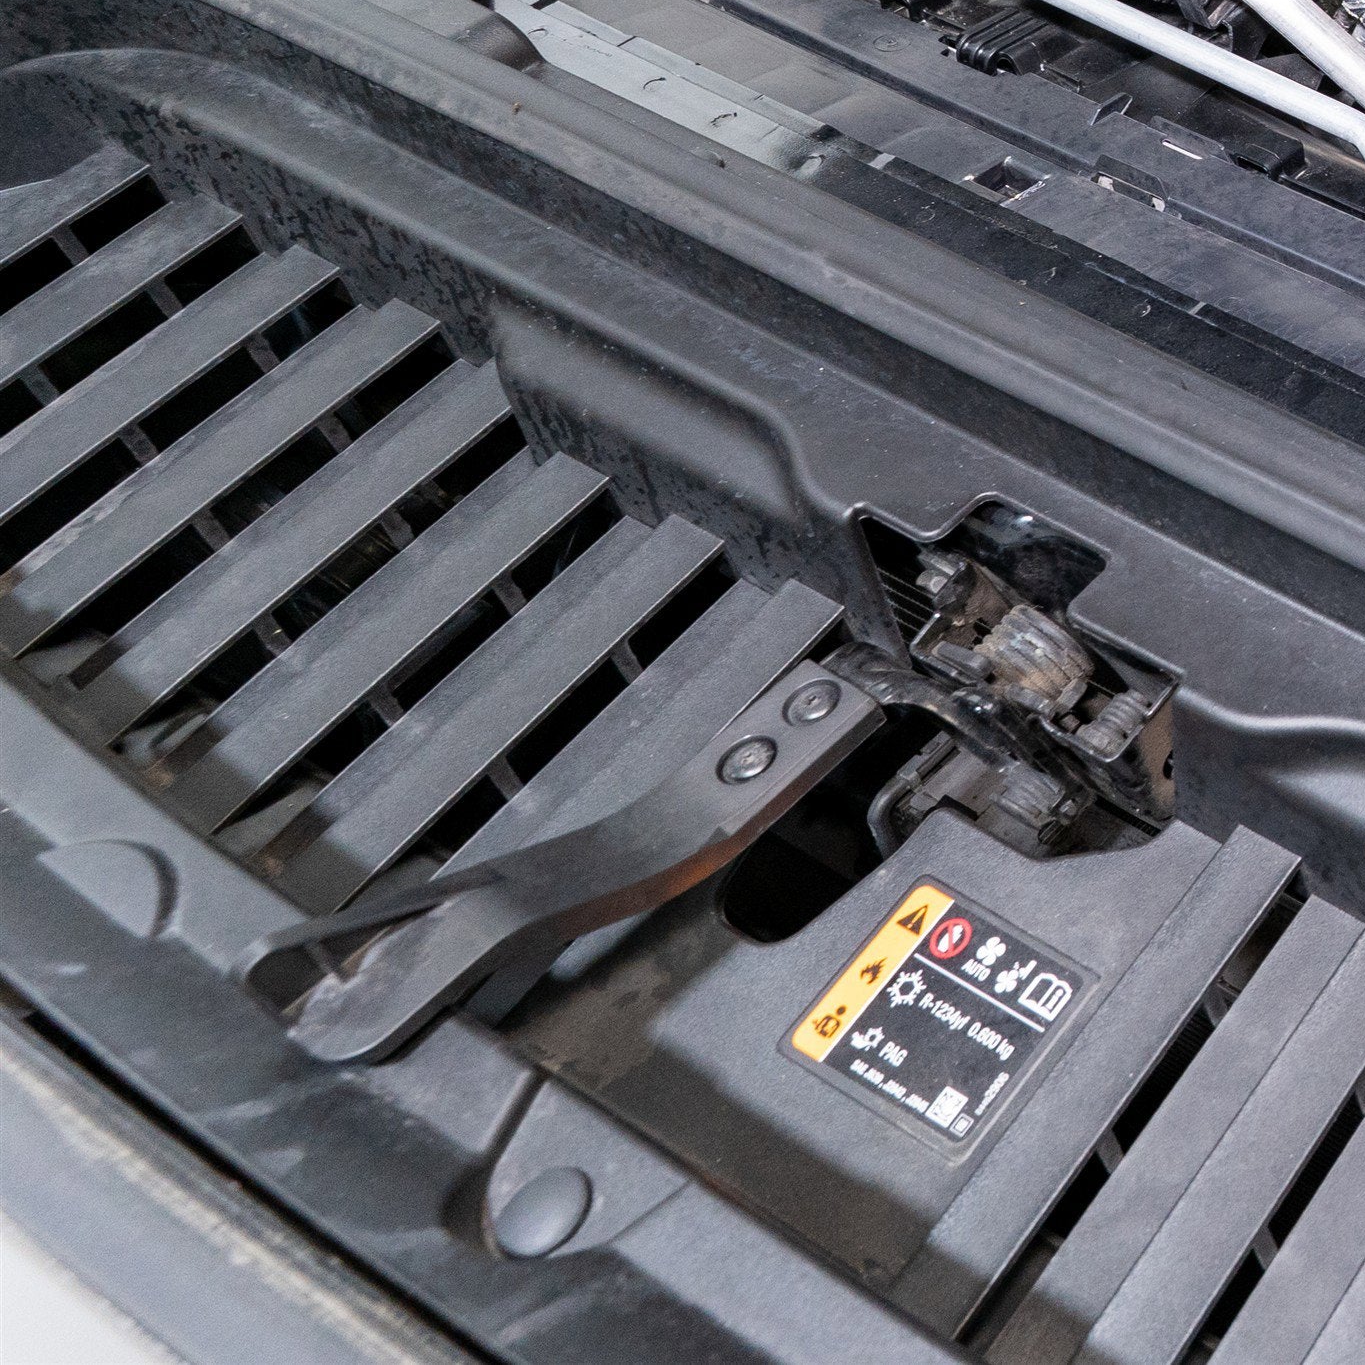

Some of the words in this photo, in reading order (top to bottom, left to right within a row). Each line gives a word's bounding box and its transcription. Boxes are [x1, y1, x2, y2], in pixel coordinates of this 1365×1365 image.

[960, 959, 991, 982] AUTO
[918, 992, 971, 1031] R-1234yf
[967, 1021, 1003, 1051] 0.600
[995, 1038, 1016, 1062] kg
[878, 1040, 908, 1068] PAG
